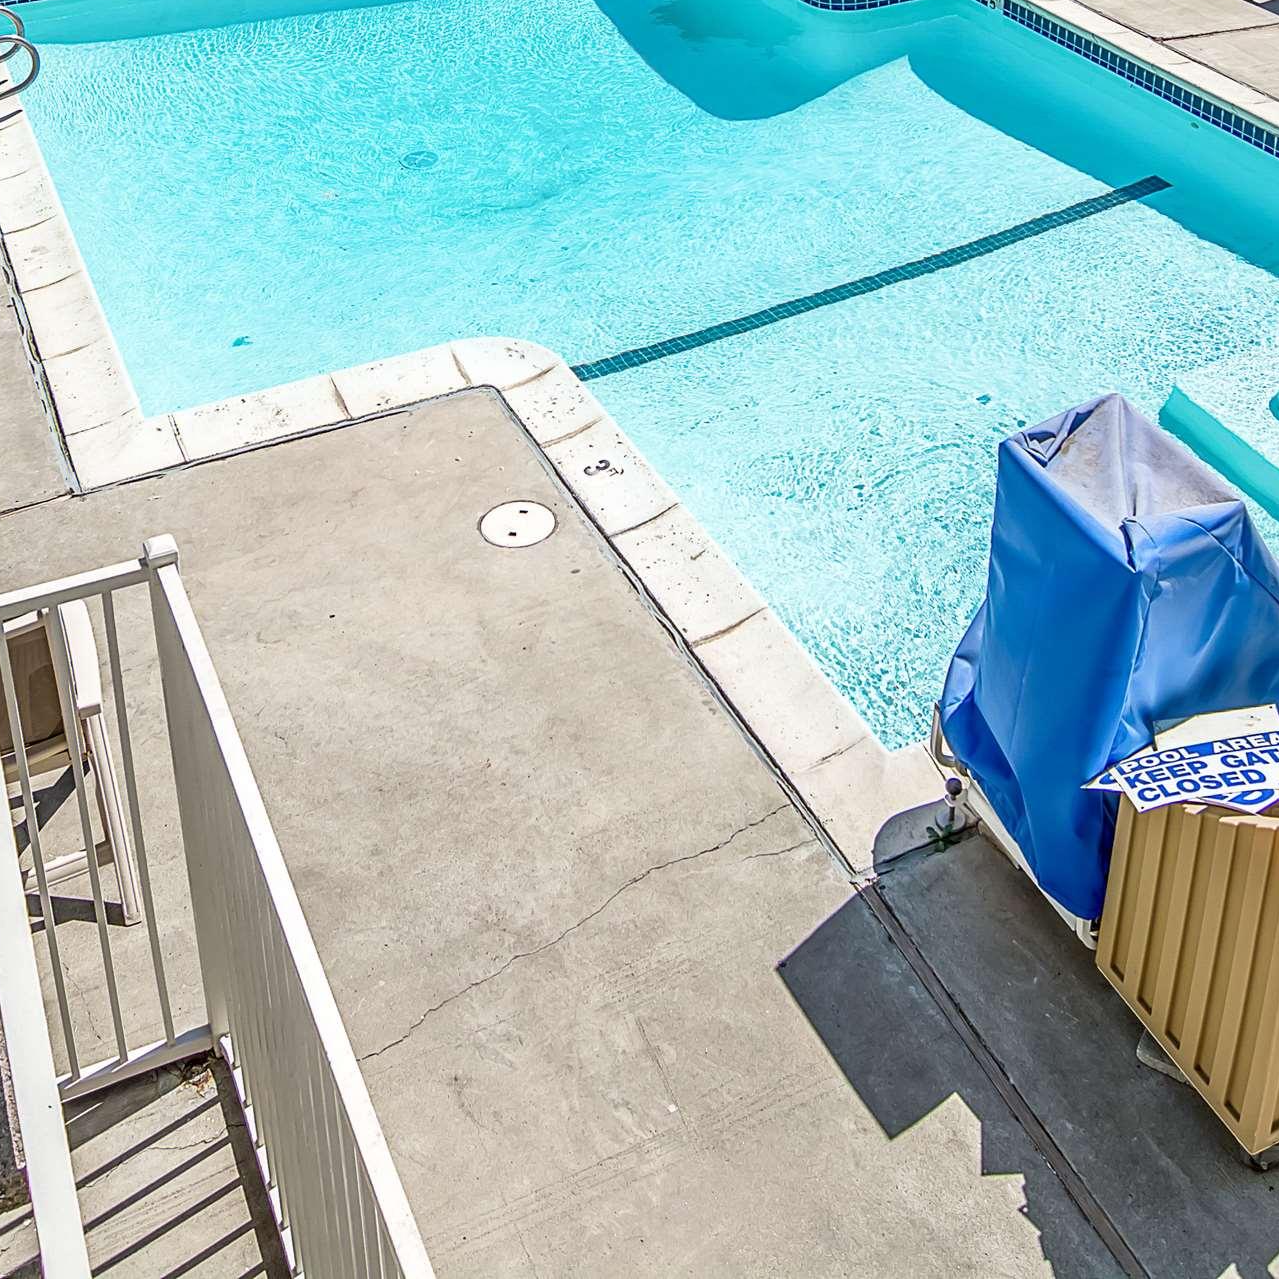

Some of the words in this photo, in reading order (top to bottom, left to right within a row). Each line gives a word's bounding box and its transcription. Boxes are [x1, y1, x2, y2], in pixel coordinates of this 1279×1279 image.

[583, 459, 610, 477] 3
[1120, 747, 1199, 775] POOL
[1123, 760, 1209, 789] KEEP
[1137, 769, 1267, 803] CLOSED
